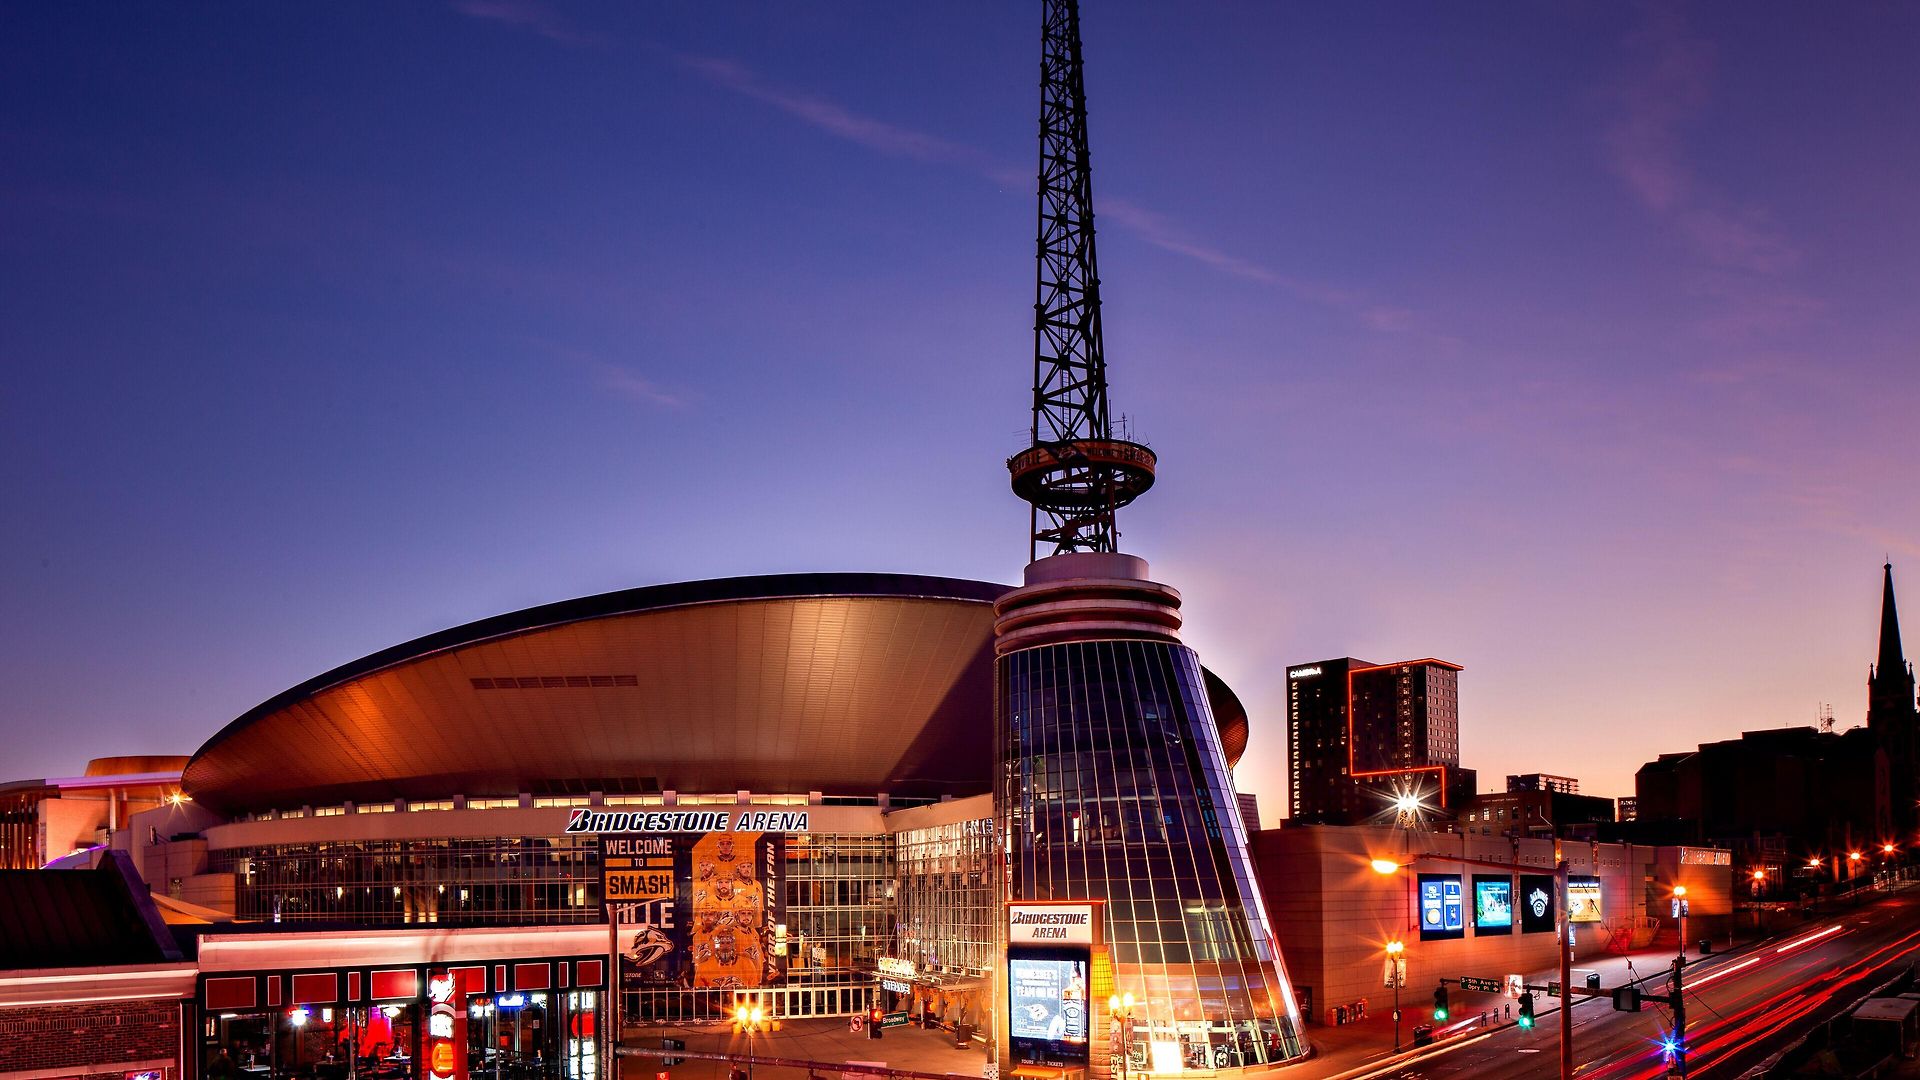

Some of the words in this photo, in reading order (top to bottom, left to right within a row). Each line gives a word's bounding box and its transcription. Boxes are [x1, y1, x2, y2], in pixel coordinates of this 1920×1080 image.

[565, 809, 730, 833] BRIDGESTONE
[735, 811, 809, 832] ARENA
[605, 839, 673, 855] WELCOME
[634, 858, 644, 867] TO
[766, 842, 775, 877] FAN
[609, 875, 670, 895] SMASH
[767, 876, 776, 908] THE
[767, 909, 777, 933] OF
[1011, 911, 1088, 925] BRIDGESTONE
[1032, 927, 1067, 939] ARENA
[767, 933, 777, 974] YEAR
[882, 1016, 905, 1024] Broadway
